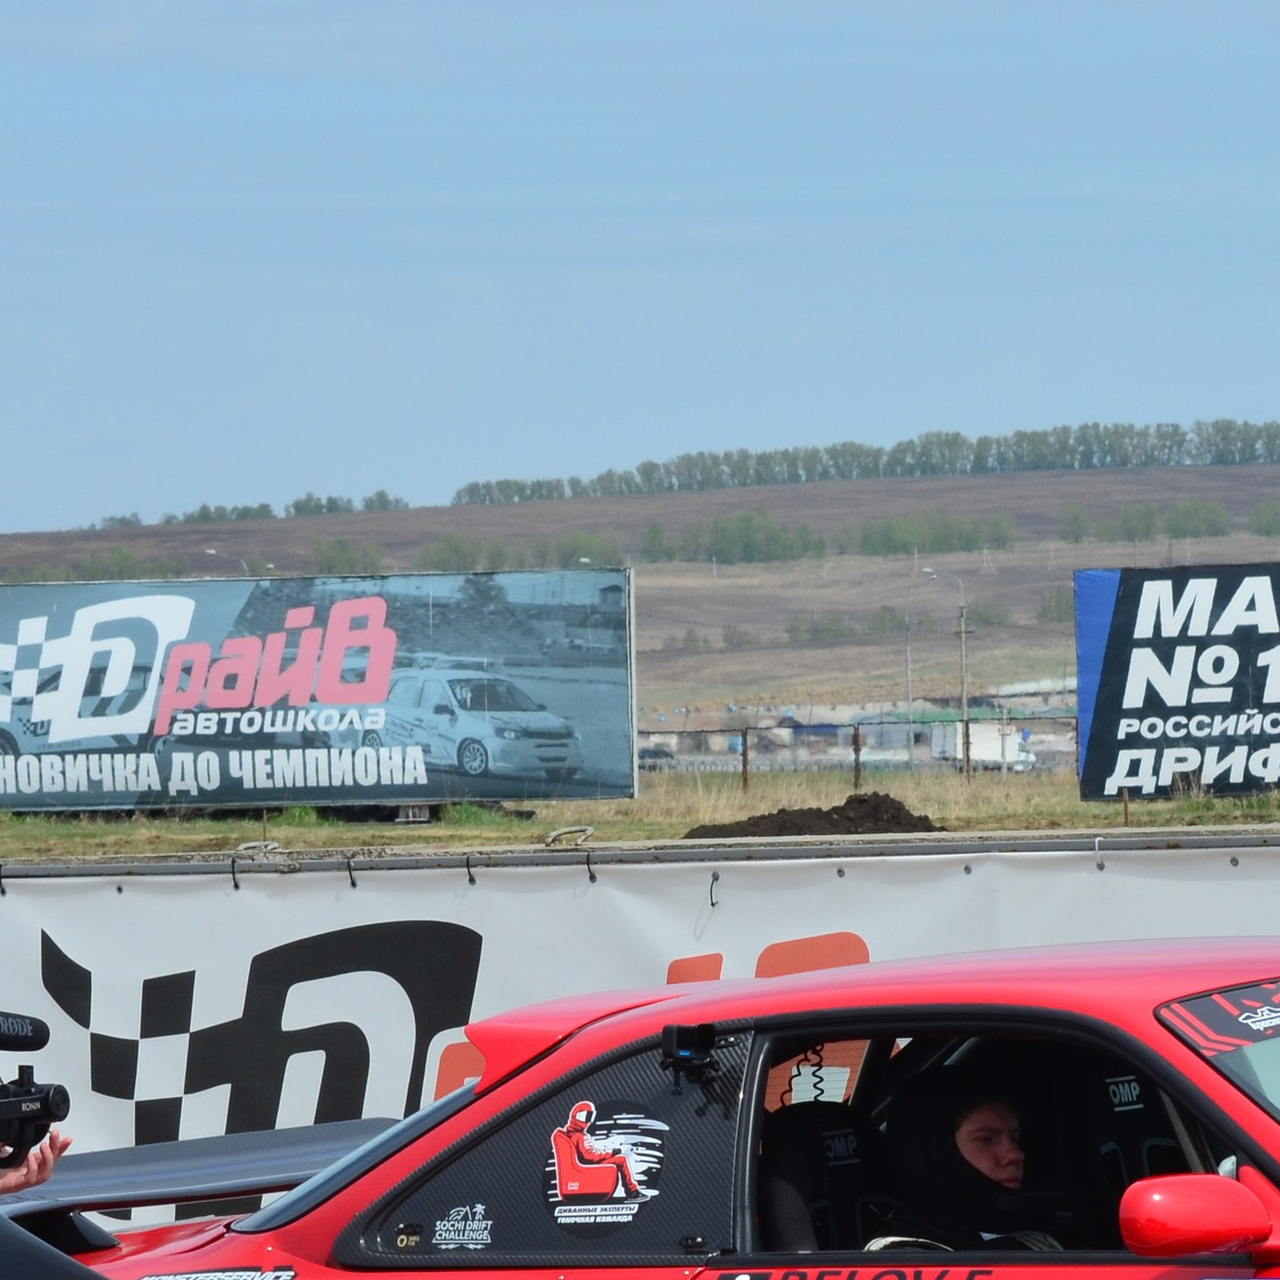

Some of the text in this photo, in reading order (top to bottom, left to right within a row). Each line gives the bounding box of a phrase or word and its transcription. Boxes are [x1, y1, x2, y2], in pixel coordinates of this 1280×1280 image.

[0, 746, 428, 796] НОВИЧКА ДО ЧЕМПИОНА
[1109, 1081, 1141, 1105] OMP
[21, 1101, 41, 1112] RONIN
[435, 1220, 493, 1231] SOCHI DRIFT
[435, 1230, 490, 1240] CHALLENGE
